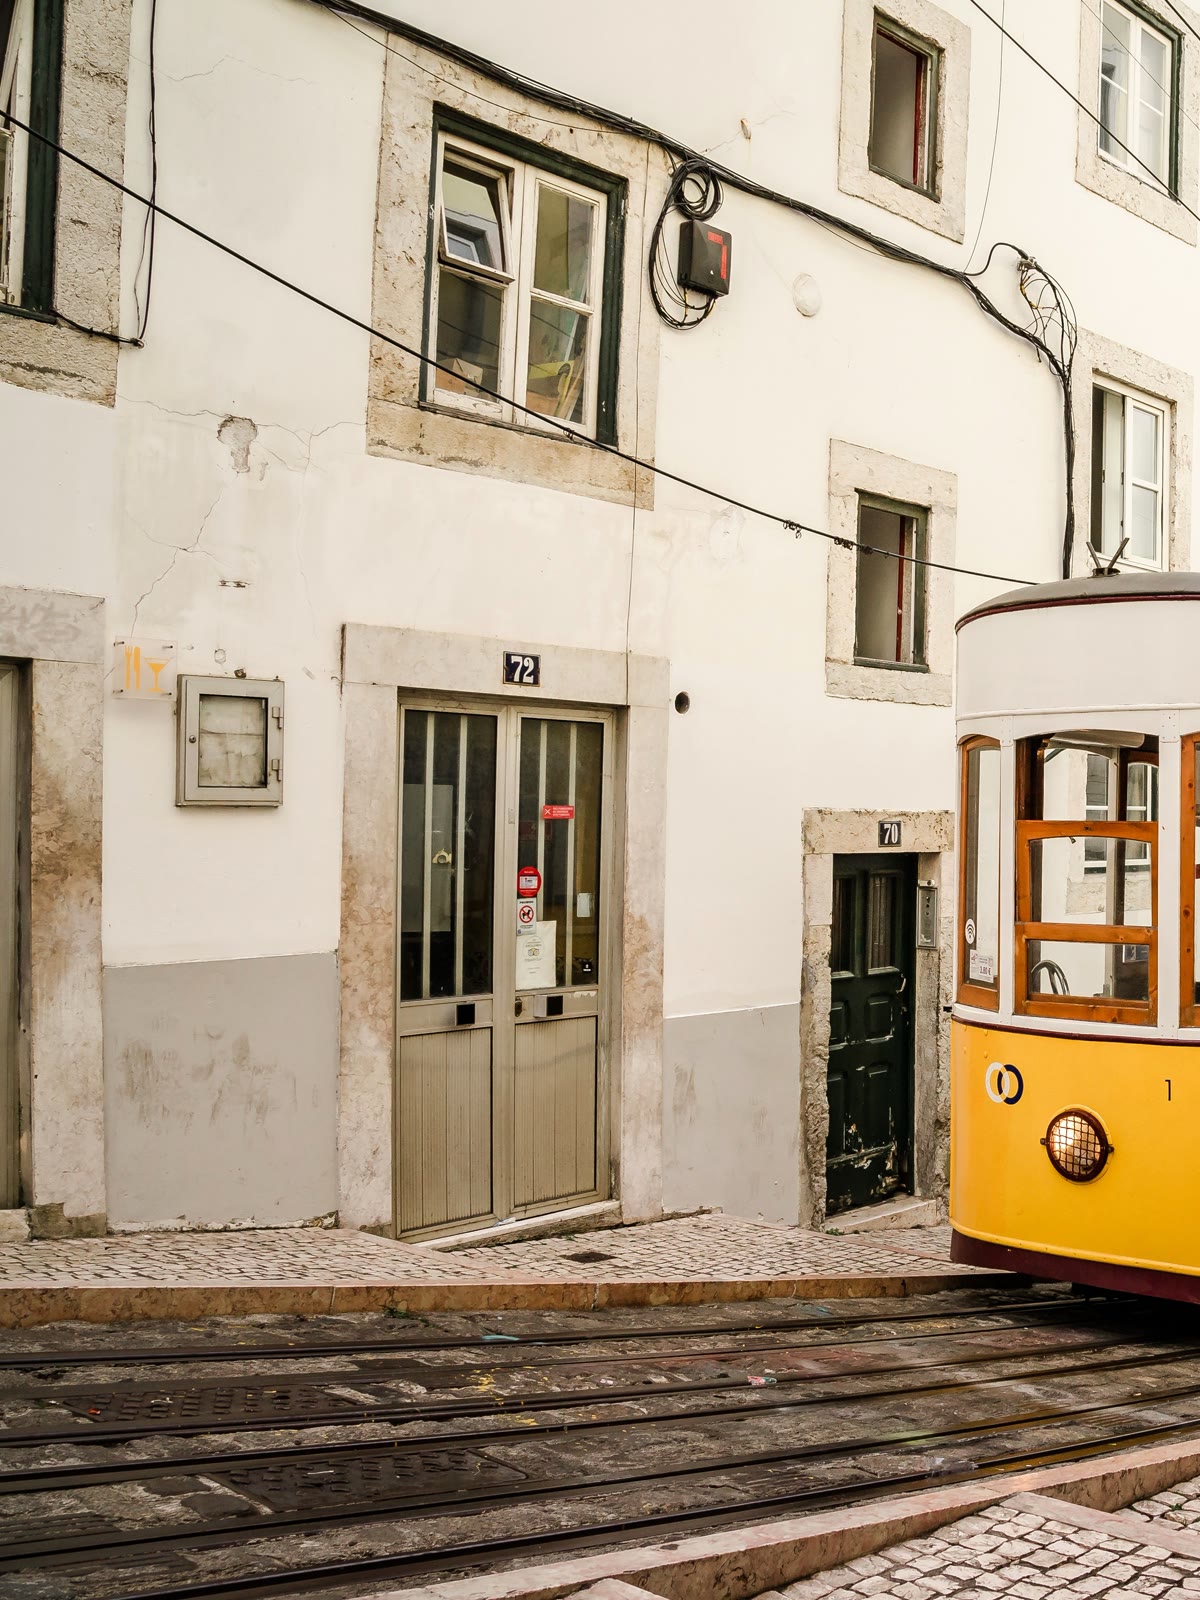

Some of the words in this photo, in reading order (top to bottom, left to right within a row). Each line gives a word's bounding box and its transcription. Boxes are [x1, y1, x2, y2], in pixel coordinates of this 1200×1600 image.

[511, 655, 534, 683] 72
[884, 823, 898, 844] 70
[1164, 1079, 1172, 1101] 1
